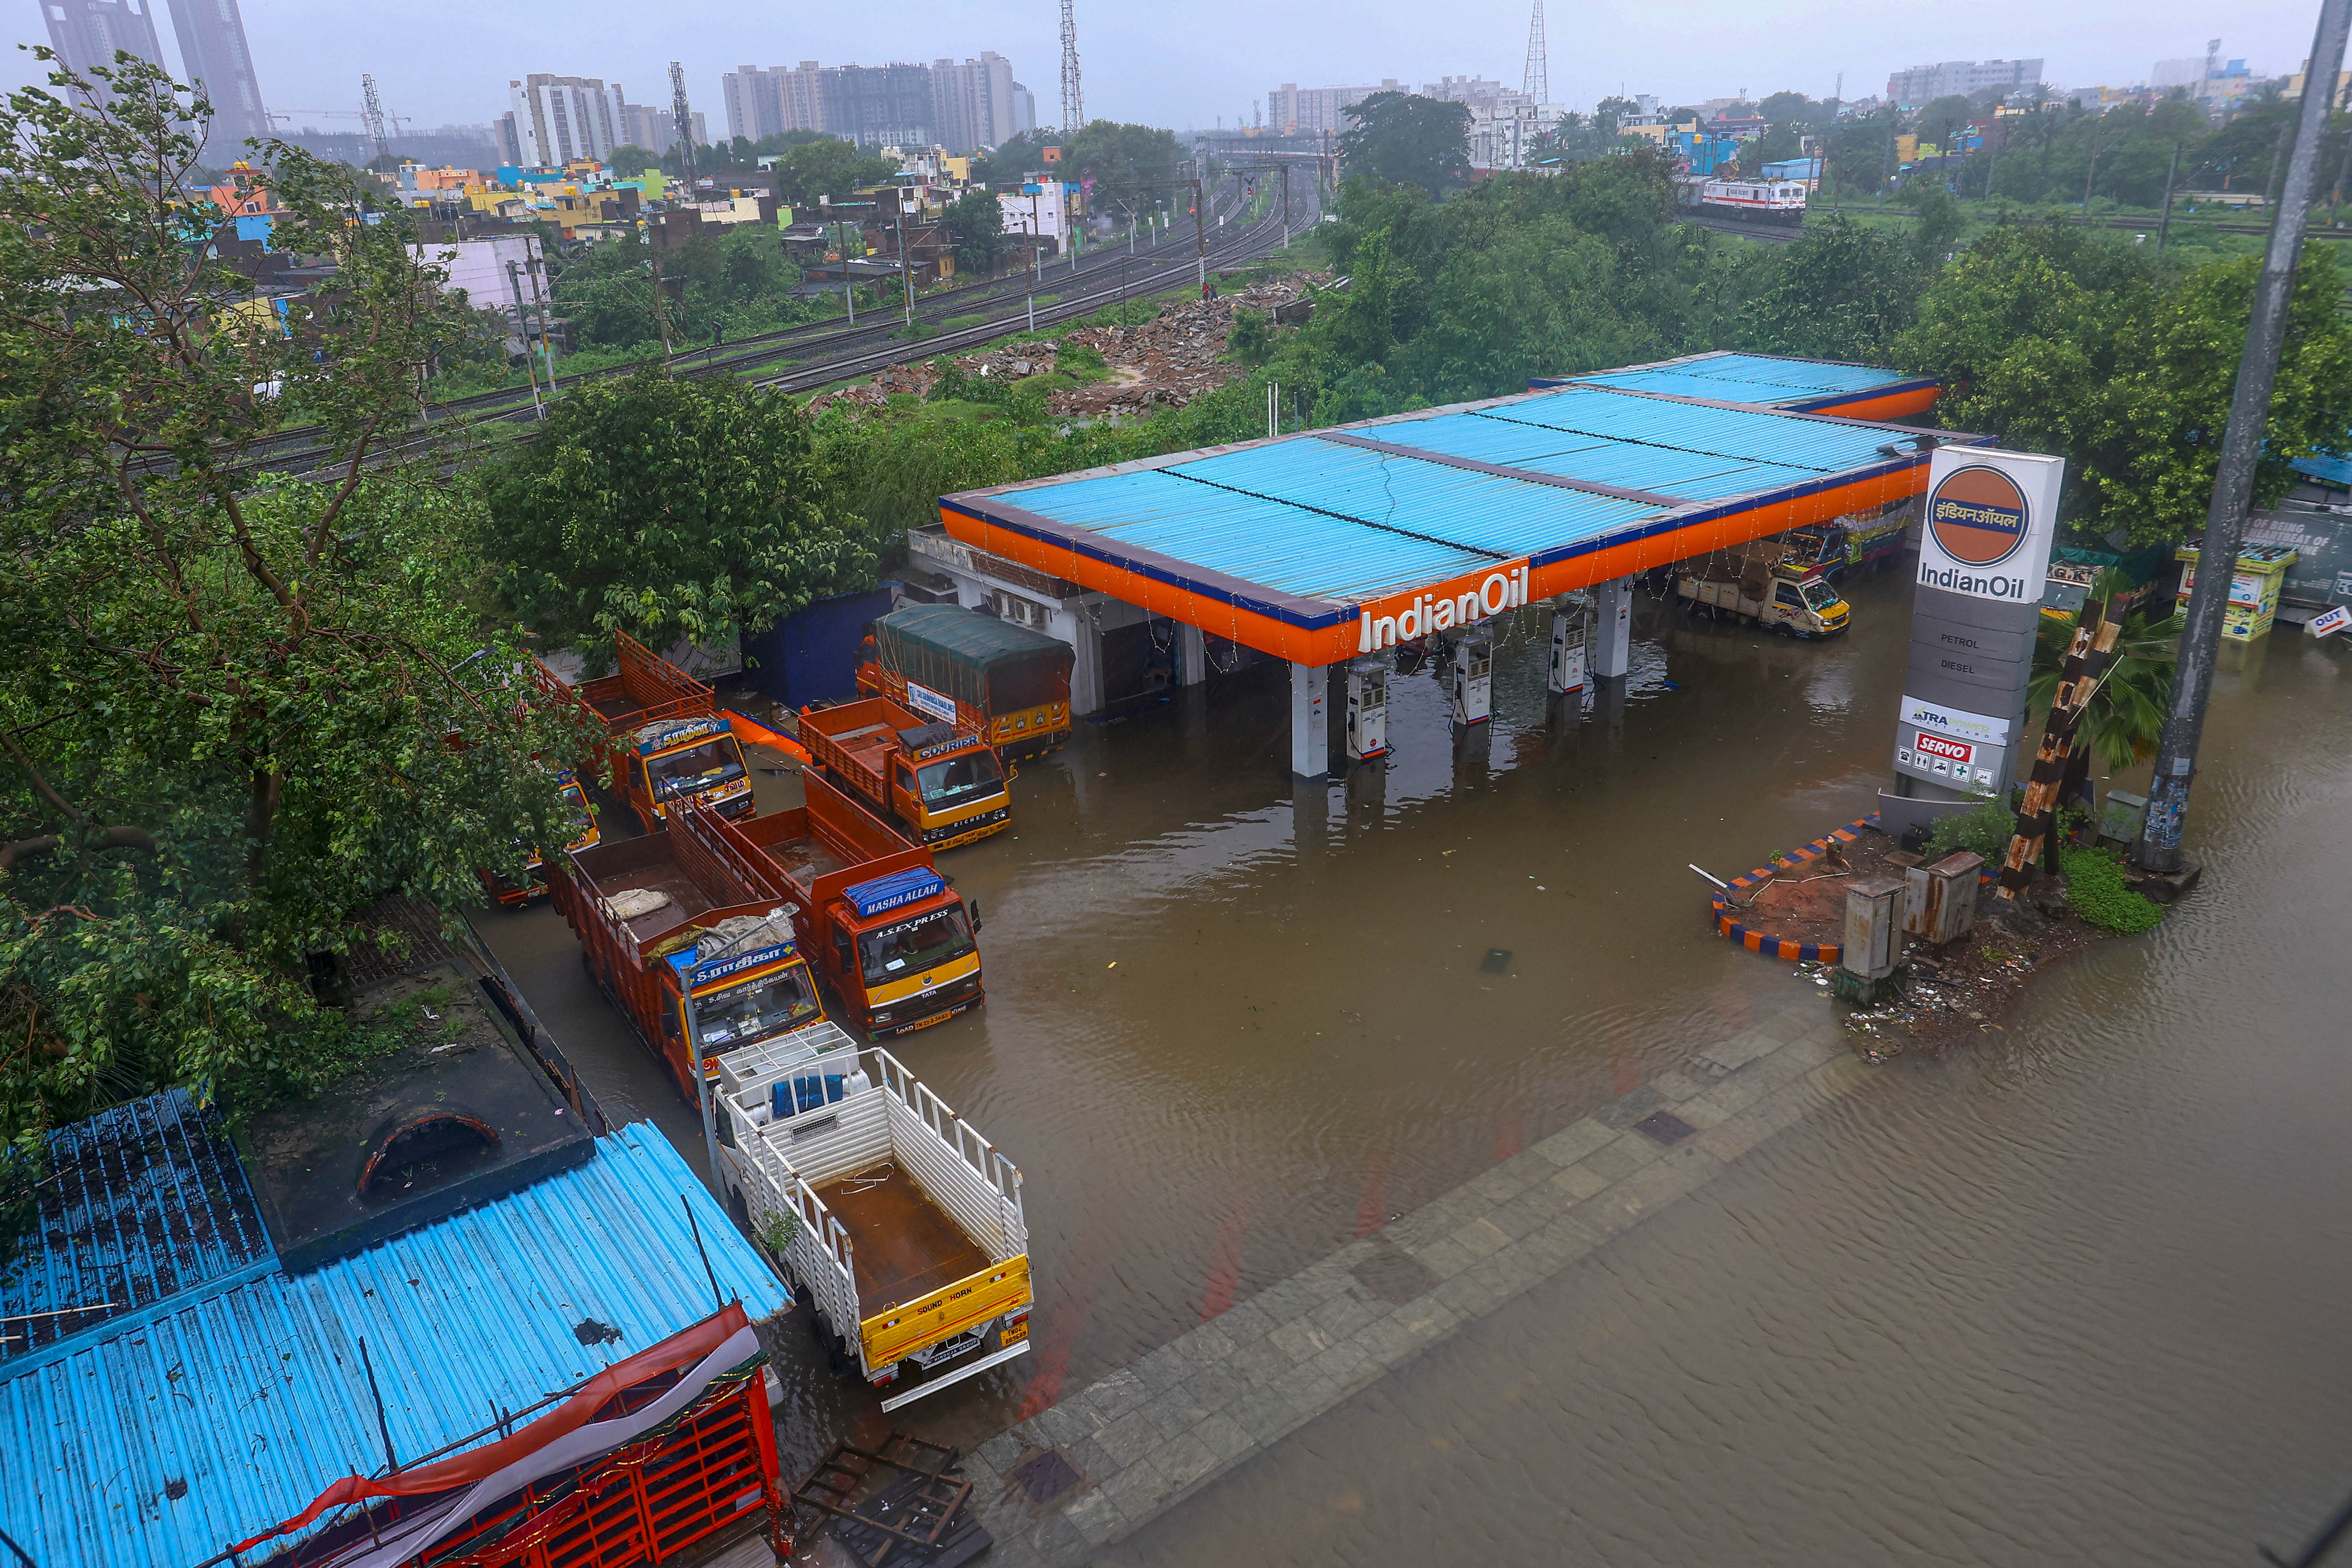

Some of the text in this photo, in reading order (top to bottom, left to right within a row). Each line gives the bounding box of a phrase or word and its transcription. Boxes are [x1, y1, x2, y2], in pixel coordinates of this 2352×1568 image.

[1936, 501, 2019, 528] इंडियनऑयल
[2254, 518, 2269, 528] OF
[2270, 520, 2305, 533] BEING
[2312, 536, 2330, 546] OF
[1921, 562, 2025, 599] IndianOil
[1358, 565, 1529, 653] IndianOil
[2316, 610, 2341, 626] OUT
[1941, 634, 1979, 649] PETROL
[1941, 660, 1975, 674] DIESEL
[1956, 728, 1989, 738] CARD
[920, 735, 980, 759] COURIER
[1919, 737, 1965, 759] SERVO
[954, 813, 987, 828] EICHER
[867, 883, 938, 915] MASHA ALLAH
[921, 990, 937, 999] TATA
[917, 1287, 973, 1316] SOUND HORN
[934, 1348, 957, 1362] HINDUJA
